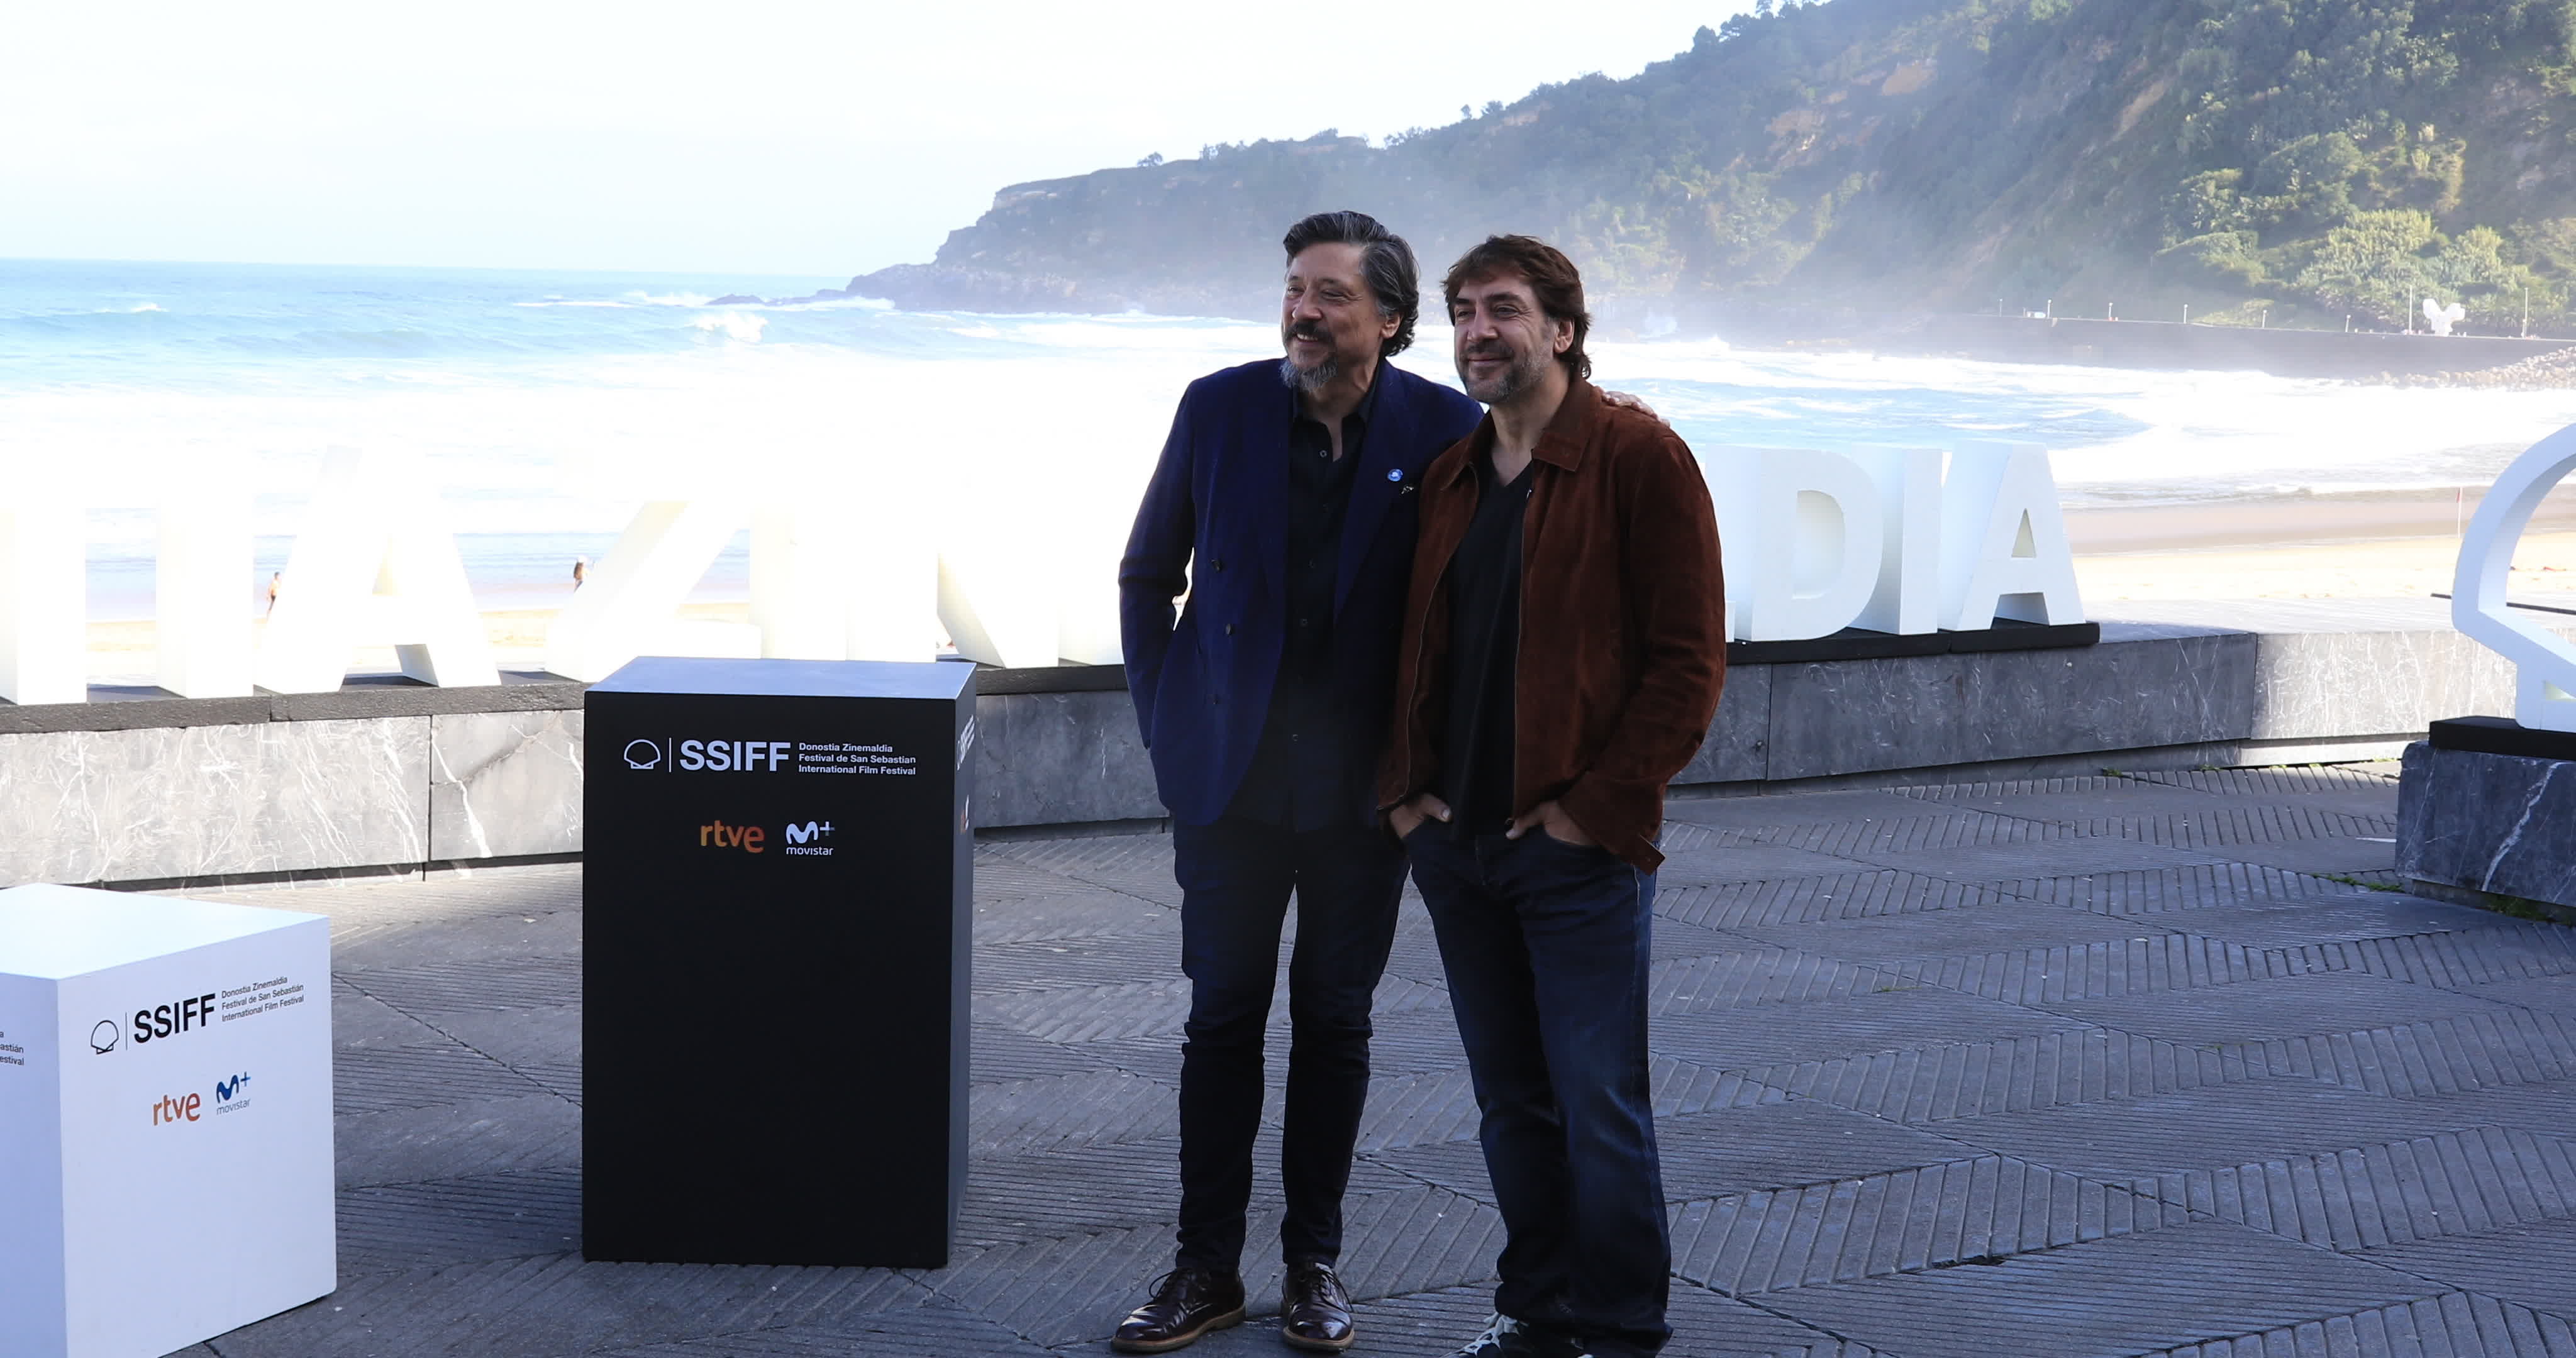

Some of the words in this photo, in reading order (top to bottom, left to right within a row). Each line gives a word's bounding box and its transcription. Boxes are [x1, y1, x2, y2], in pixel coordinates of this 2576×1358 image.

[679, 739, 791, 771] SSIFF
[799, 742, 840, 751] Donostia
[842, 744, 893, 753] Zinemaldia
[799, 754, 834, 762] Festival
[836, 754, 848, 763] de
[850, 755, 868, 763] San
[799, 765, 857, 774] International
[858, 766, 879, 774] Film
[880, 766, 916, 775] Festival
[700, 820, 765, 853] rtve
[786, 847, 834, 856] movistar
[221, 985, 251, 998] Donostia
[252, 976, 288, 991] Zinemaldia
[221, 1005, 264, 1022] International
[264, 1002, 279, 1012] Film
[279, 995, 304, 1008] Festival
[222, 997, 247, 1010] Festival
[248, 995, 257, 1004] de
[258, 993, 271, 1002] San
[134, 993, 216, 1044] SSIFF
[153, 1093, 201, 1127] rtve
[216, 1098, 251, 1115] movistar
